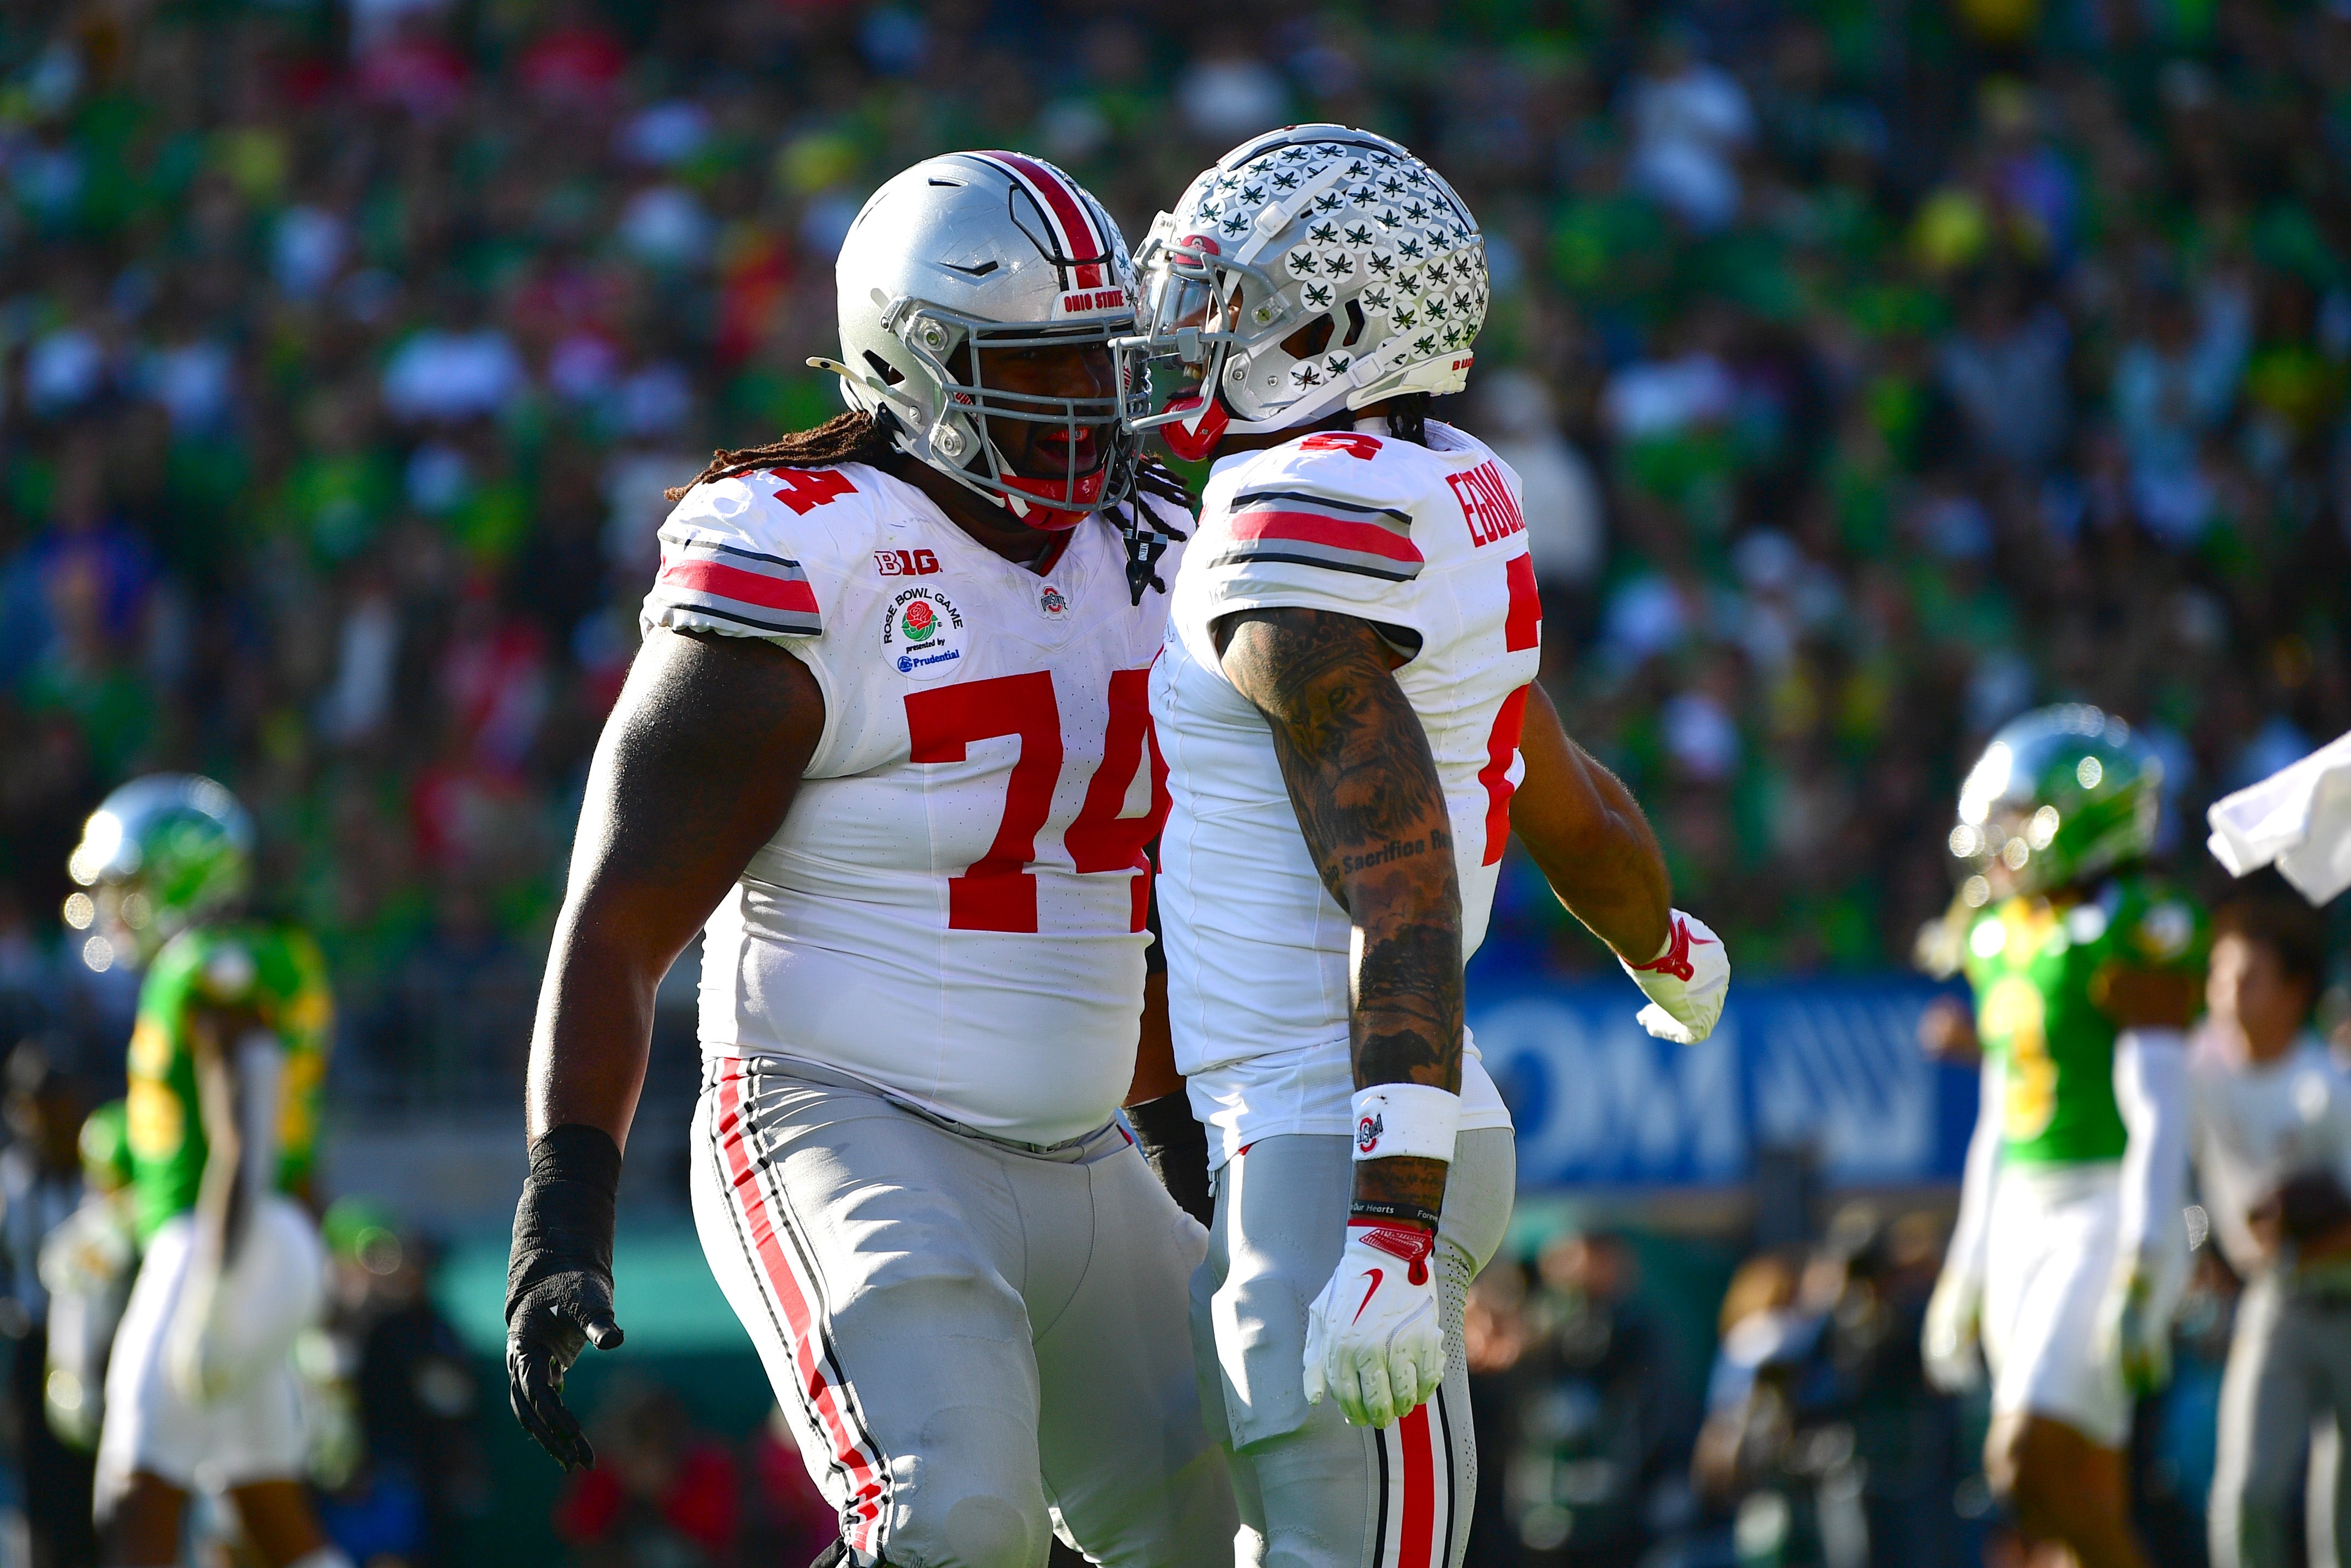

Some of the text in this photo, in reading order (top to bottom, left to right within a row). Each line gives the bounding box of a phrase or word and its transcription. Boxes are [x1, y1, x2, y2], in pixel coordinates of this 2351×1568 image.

[1065, 290, 1125, 313] OHIO STATE
[883, 587, 963, 644] ROSE BOWL GAME
[906, 638, 945, 654] presented by
[912, 649, 960, 668] Prudential
[903, 669, 1173, 933] 74
[1366, 1204, 1394, 1214] Hearts
